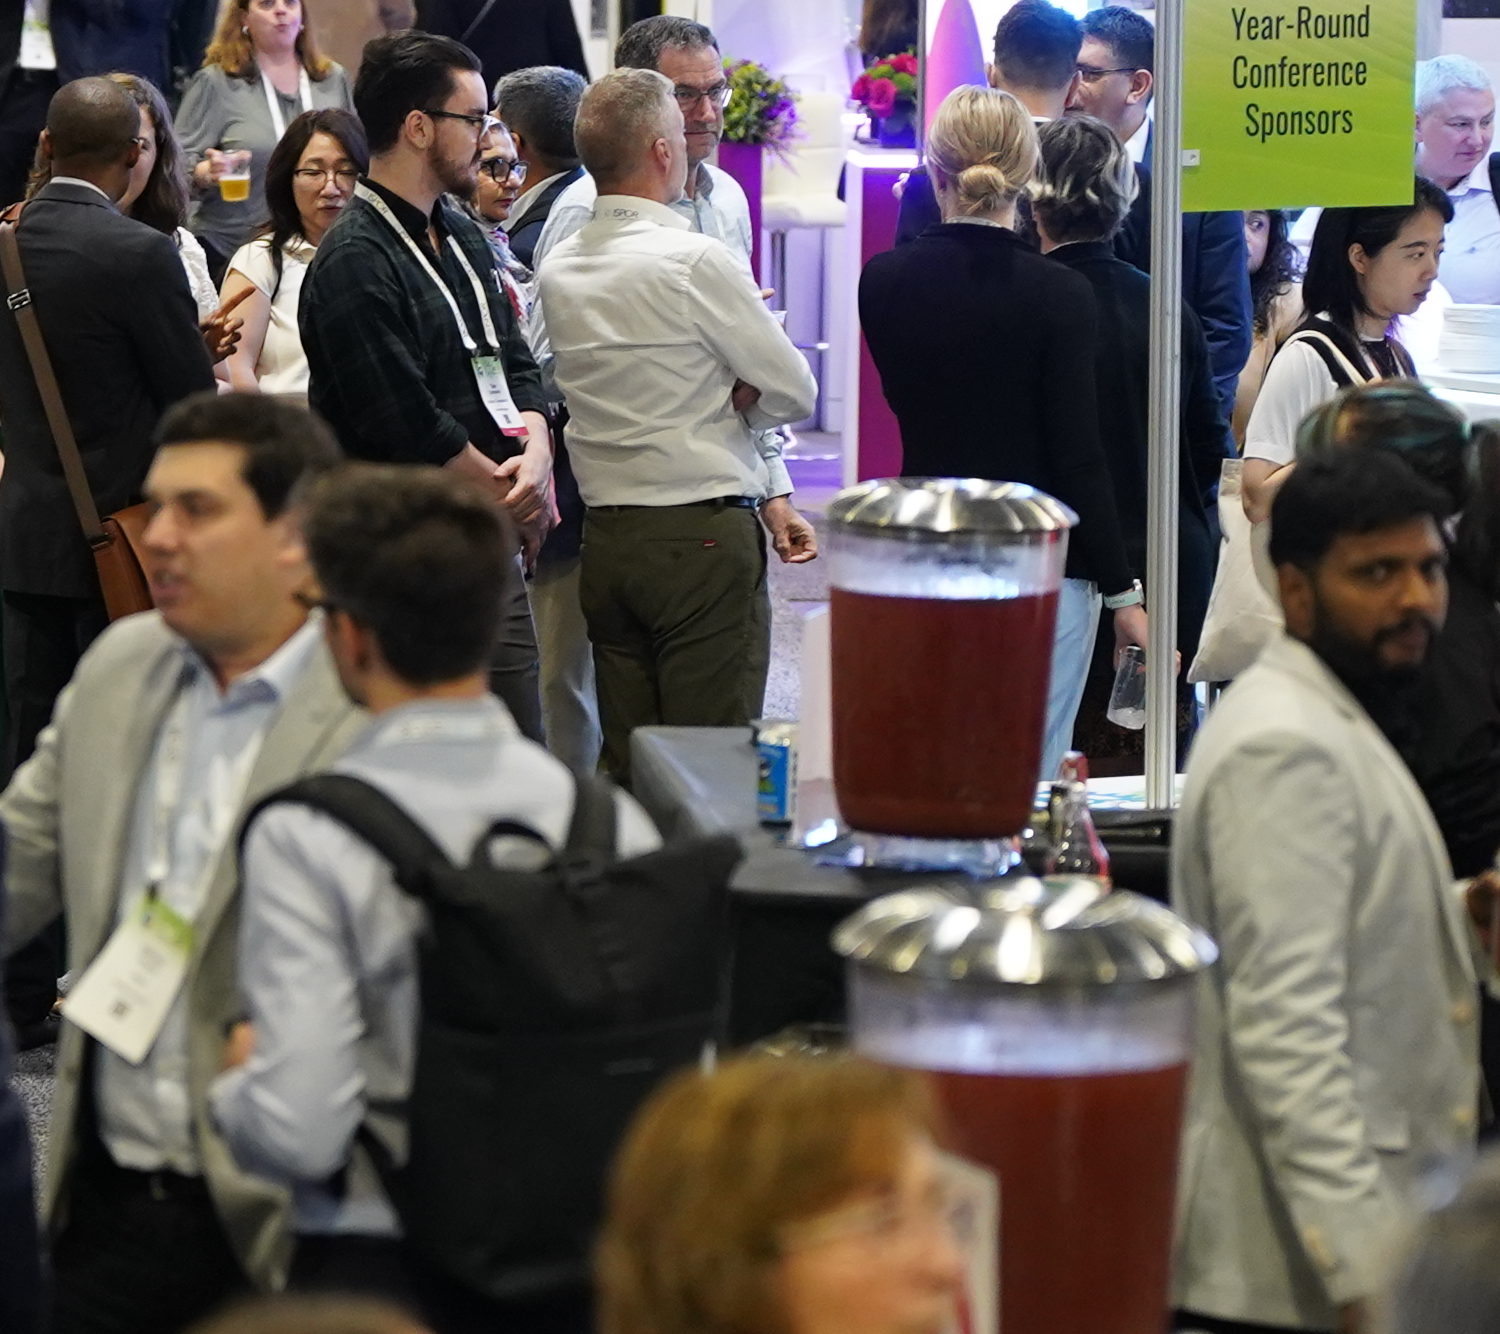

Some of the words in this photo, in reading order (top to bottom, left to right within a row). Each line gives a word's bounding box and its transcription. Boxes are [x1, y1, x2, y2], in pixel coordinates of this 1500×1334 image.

[1232, 5, 1370, 42] Year-Round
[1233, 55, 1367, 90] Conference
[1245, 103, 1353, 143] Sponsors
